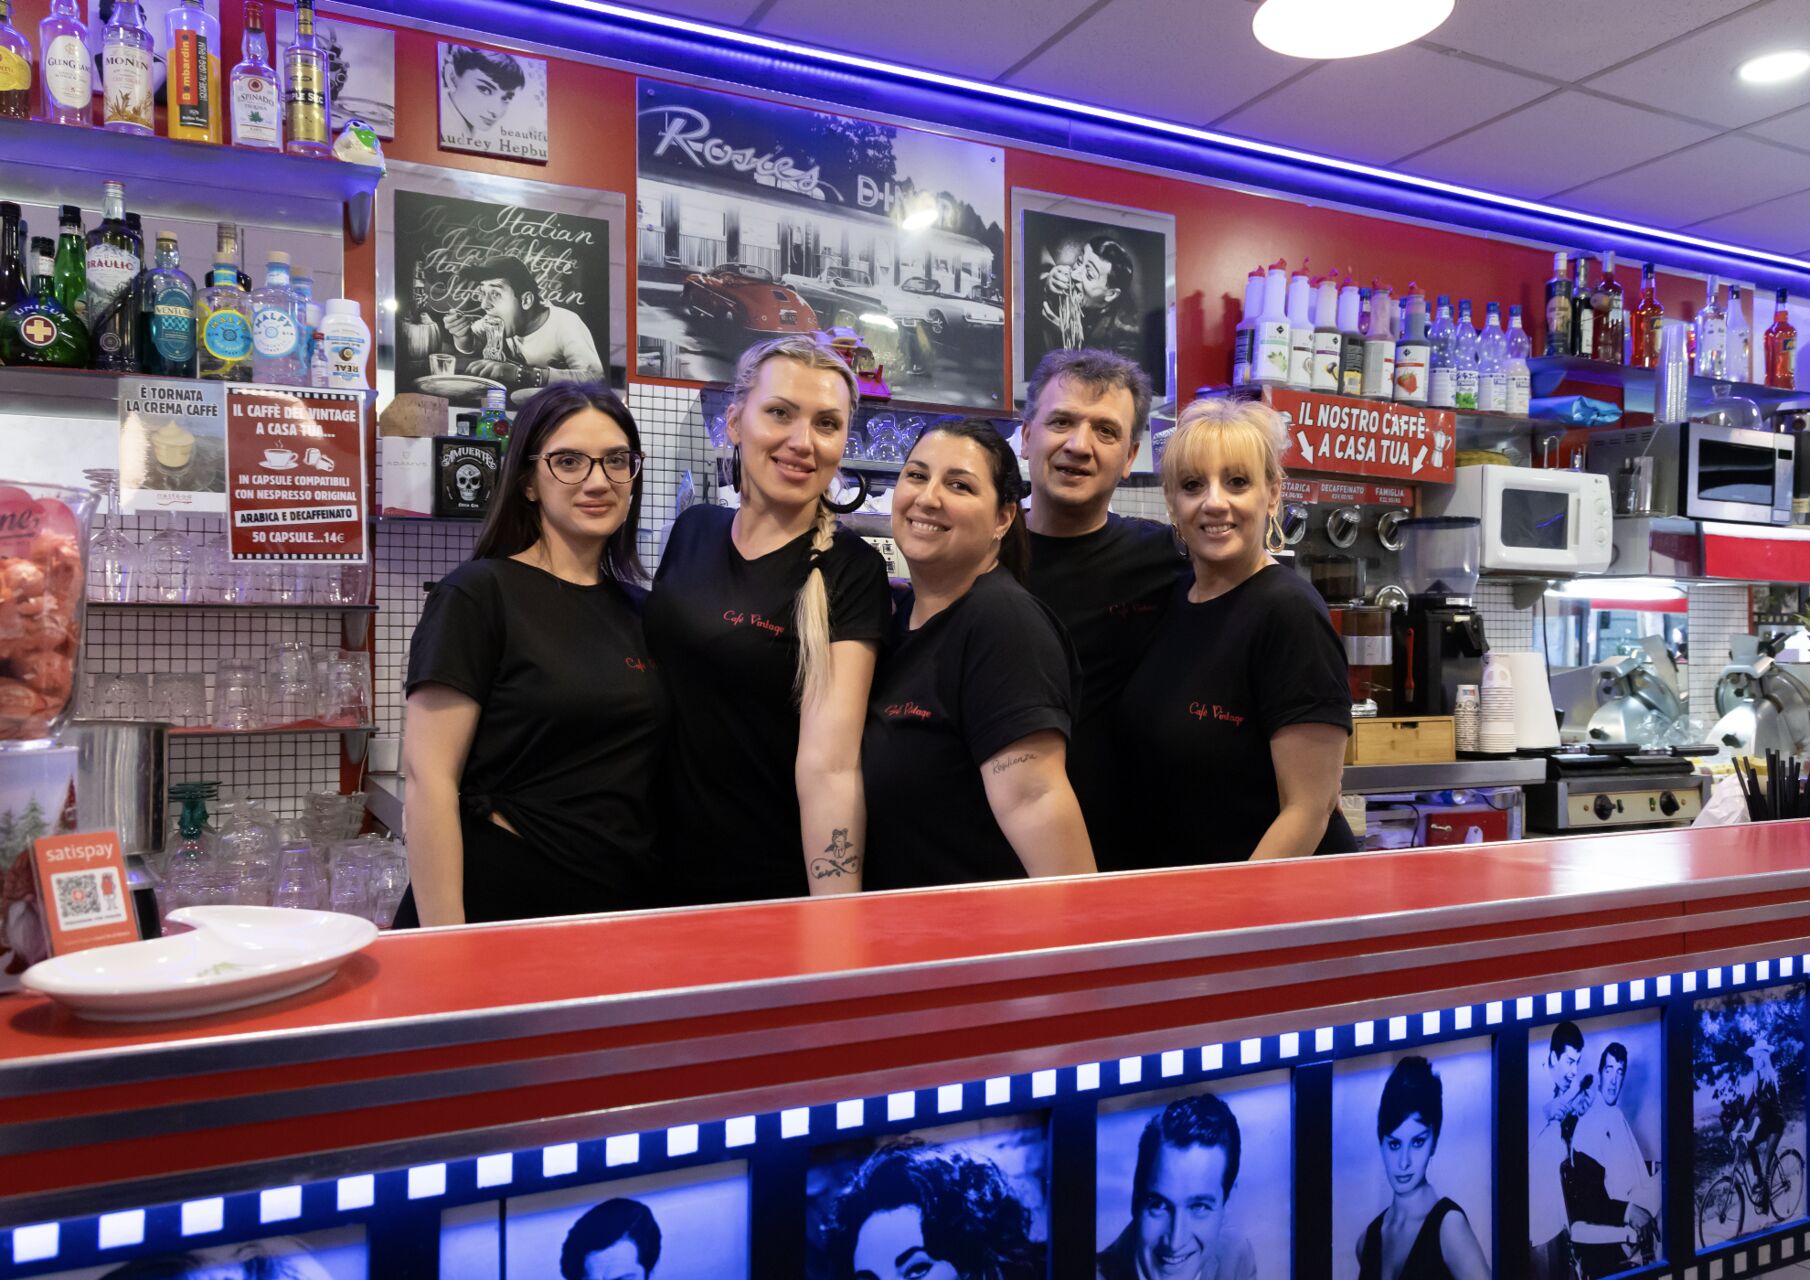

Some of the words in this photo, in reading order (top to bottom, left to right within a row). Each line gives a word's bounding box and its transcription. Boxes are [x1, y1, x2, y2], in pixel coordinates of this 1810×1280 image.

[106, 56, 149, 71] MONIN
[478, 206, 595, 245] Italian
[14, 304, 70, 323] UNICUM
[334, 364, 359, 372] REAL
[140, 384, 147, 399] È
[150, 387, 204, 402] TORNATA
[126, 400, 140, 412] LA
[144, 402, 183, 415] CREMA
[186, 403, 218, 417] CAFFÈ
[232, 404, 244, 417] IL
[247, 403, 281, 418] CAFFÈ
[309, 408, 356, 422] VINTAGE
[256, 422, 265, 435] A
[268, 422, 298, 436] CASA
[1298, 401, 1314, 426] IL
[1316, 404, 1380, 434] NOSTRO
[1381, 412, 1426, 440] CAFFÈ
[1317, 432, 1331, 458] A
[1334, 435, 1376, 463] CASA
[1380, 439, 1410, 466] TUA
[239, 475, 249, 484] IN
[252, 475, 292, 485] CAPSULE
[294, 476, 350, 487] COMPATIBILI
[1280, 481, 1311, 493] STARICA
[1321, 483, 1365, 494] DECAFFEINATO
[1375, 487, 1405, 497] FAMIGLIA
[235, 489, 254, 499] CON
[257, 490, 312, 500] NESPRESSO
[314, 491, 357, 501] ORIGINAL
[240, 512, 279, 524] ARABICA
[282, 511, 287, 521] E
[290, 508, 352, 520] DECAFFEINATO
[252, 531, 265, 543] 50
[750, 613, 785, 636] Vintage
[46, 843, 113, 862] satispay
